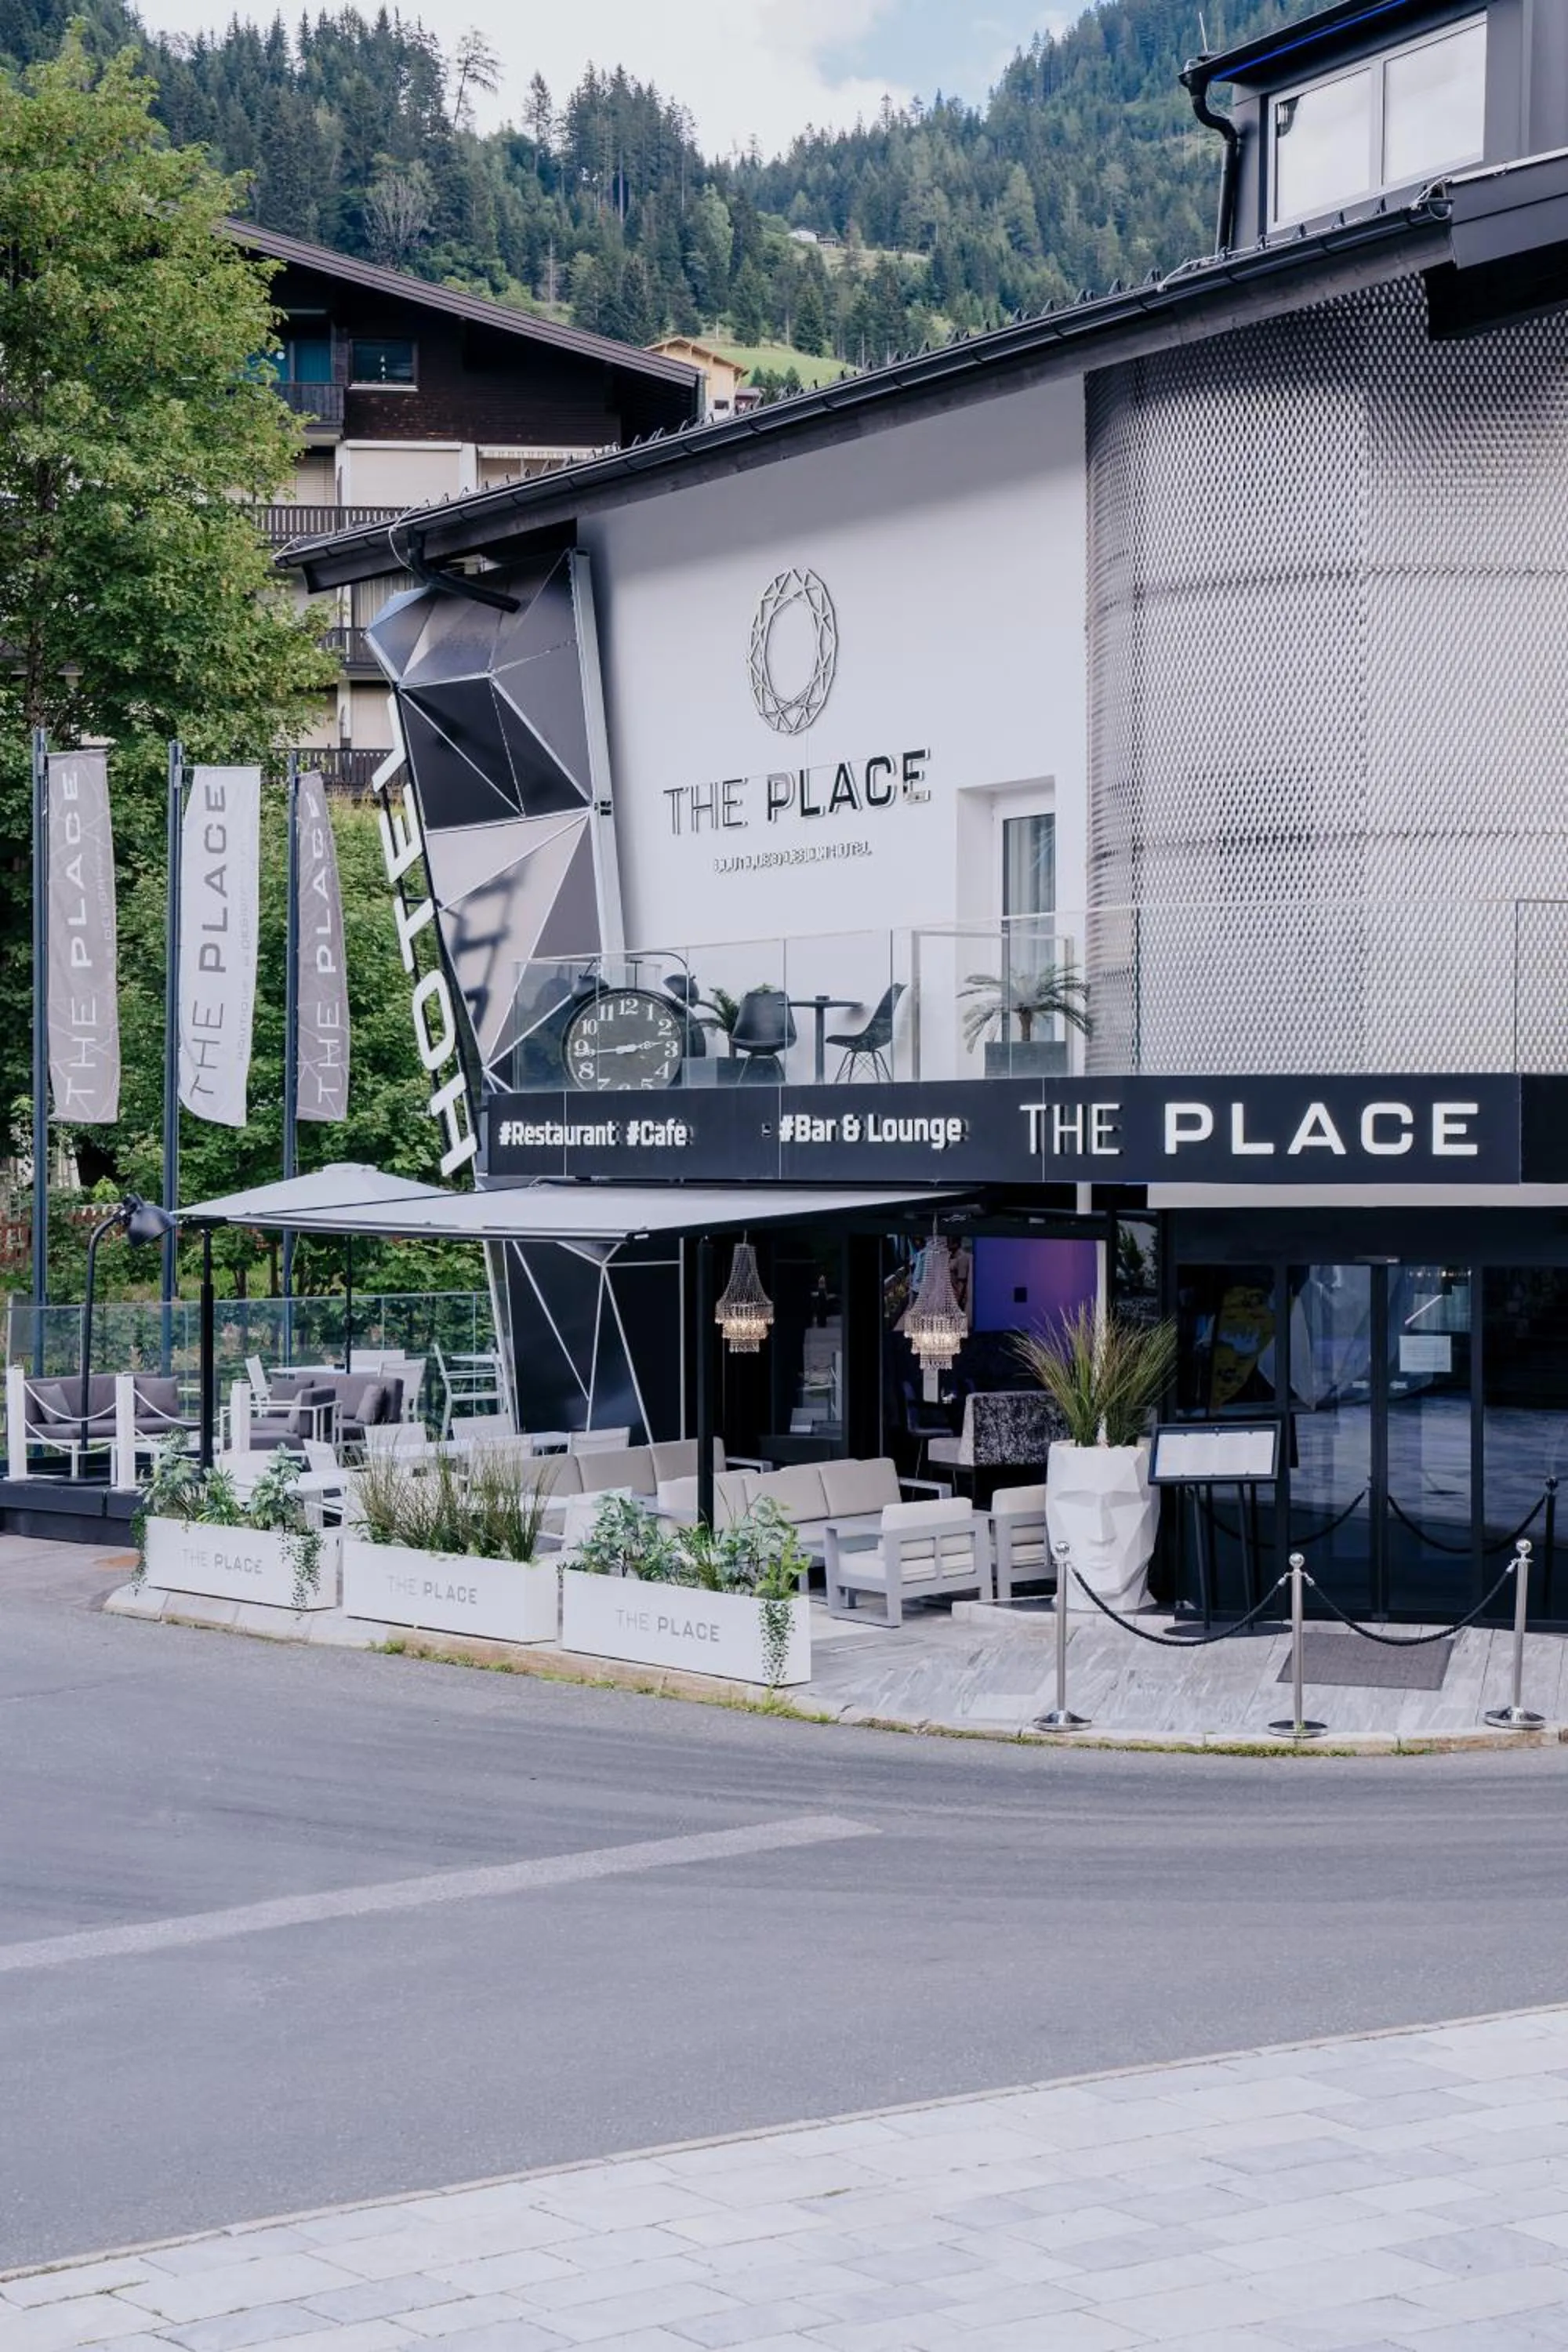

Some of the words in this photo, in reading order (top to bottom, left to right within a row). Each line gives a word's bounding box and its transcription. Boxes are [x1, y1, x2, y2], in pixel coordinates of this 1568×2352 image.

[663, 778, 749, 835] THE
[766, 747, 931, 824] PLACE
[64, 771, 93, 968] PLACE
[198, 783, 227, 973] PLACE
[371, 692, 477, 1176] HOTEL
[64, 991, 96, 1105] THE
[190, 1001, 223, 1098] THE
[318, 1001, 339, 1104] THE
[655, 1062, 669, 1079] 4
[664, 1040, 678, 1058] 3
[578, 1062, 595, 1080] 8
[498, 1120, 618, 1147] #Restaurant
[779, 1114, 837, 1142] #Bar
[842, 1115, 861, 1142] &
[868, 1113, 963, 1149] Lounge
[1019, 1103, 1123, 1155] THE
[1164, 1102, 1479, 1156] PLACE
[181, 1548, 209, 1567] THE
[214, 1553, 263, 1574] PLACE
[388, 1575, 418, 1595] THE
[423, 1581, 477, 1605] PLACE
[616, 1610, 650, 1632] THE
[657, 1616, 720, 1642] PLACE
